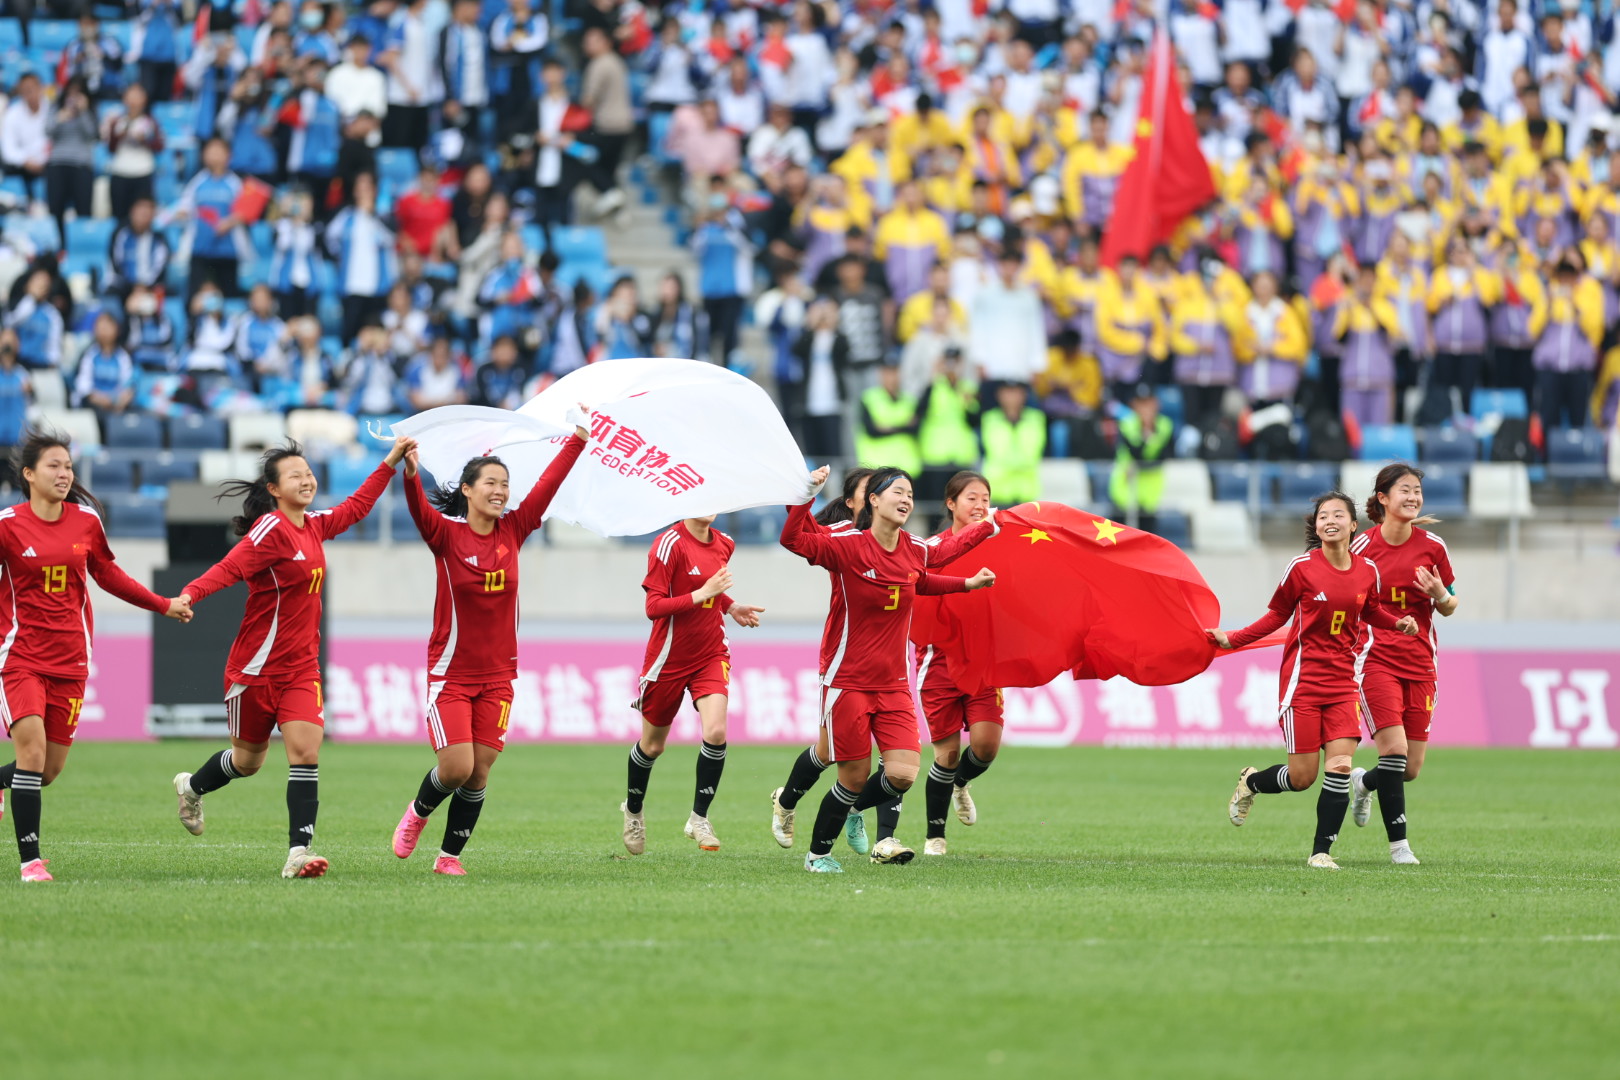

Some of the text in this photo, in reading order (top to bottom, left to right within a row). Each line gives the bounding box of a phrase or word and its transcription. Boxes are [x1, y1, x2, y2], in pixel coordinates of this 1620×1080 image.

[42, 565, 67, 593] 19
[308, 567, 323, 594] 11
[485, 569, 506, 592] 10
[884, 585, 900, 611] 3
[1391, 587, 1406, 609] 4
[1330, 611, 1346, 635] 8
